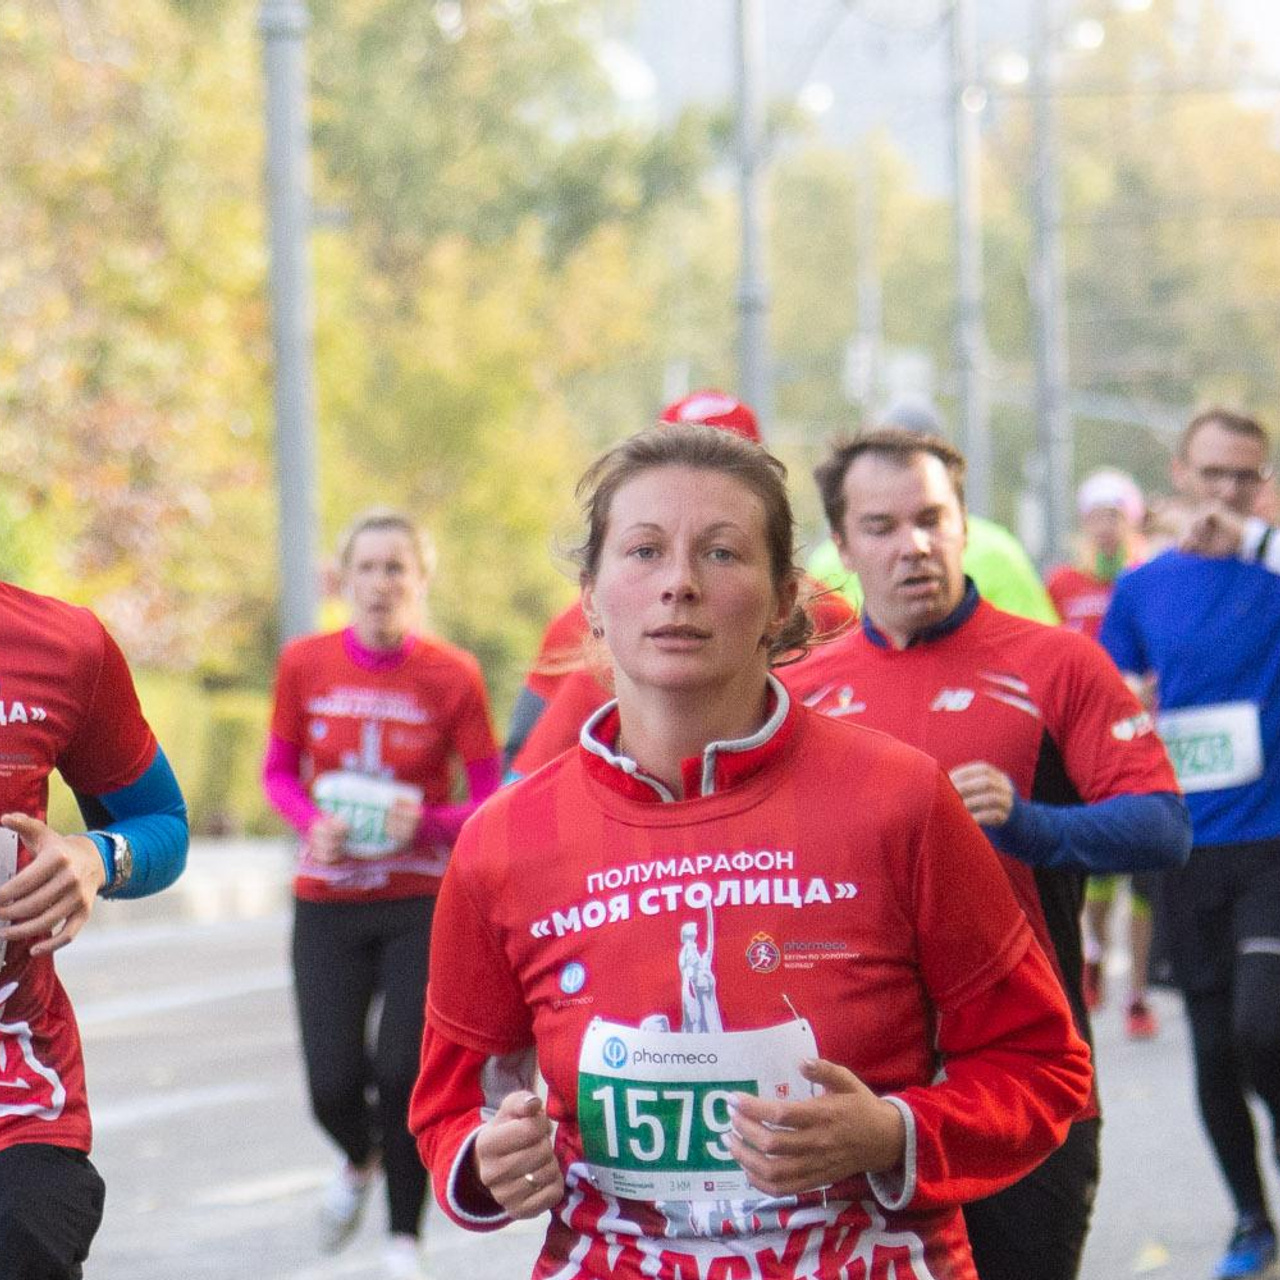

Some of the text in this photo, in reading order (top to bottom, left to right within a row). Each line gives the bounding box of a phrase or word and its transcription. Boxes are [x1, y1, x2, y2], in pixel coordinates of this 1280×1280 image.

[586, 851, 795, 893] ПОЛУМАРАФОН
[530, 877, 858, 938] «МОЯ СТОЛИЦА»
[632, 1047, 719, 1065] pharmeco
[592, 1085, 736, 1163] 1579
